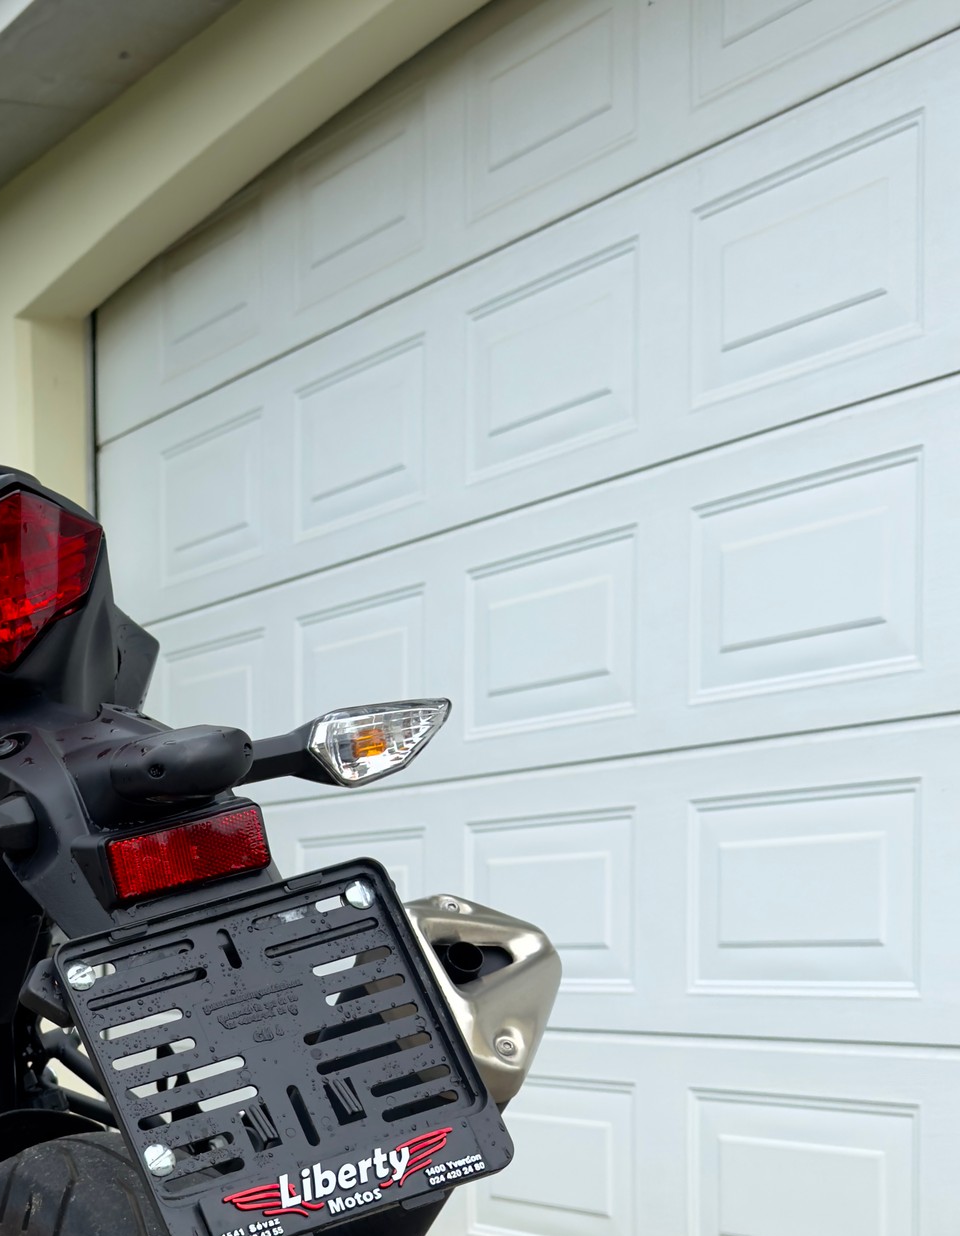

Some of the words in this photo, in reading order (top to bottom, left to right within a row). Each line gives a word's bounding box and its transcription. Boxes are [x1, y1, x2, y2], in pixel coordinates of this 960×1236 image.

[425, 1164, 446, 1176] 1400
[446, 1154, 482, 1169] Yverdon
[429, 1174, 446, 1185] 024
[446, 1169, 462, 1179] 420
[462, 1165, 474, 1175] 24
[474, 1161, 485, 1171] 80
[278, 1146, 410, 1209] Liberty
[328, 1187, 382, 1215] Motos
[272, 1226, 284, 1236] 55
